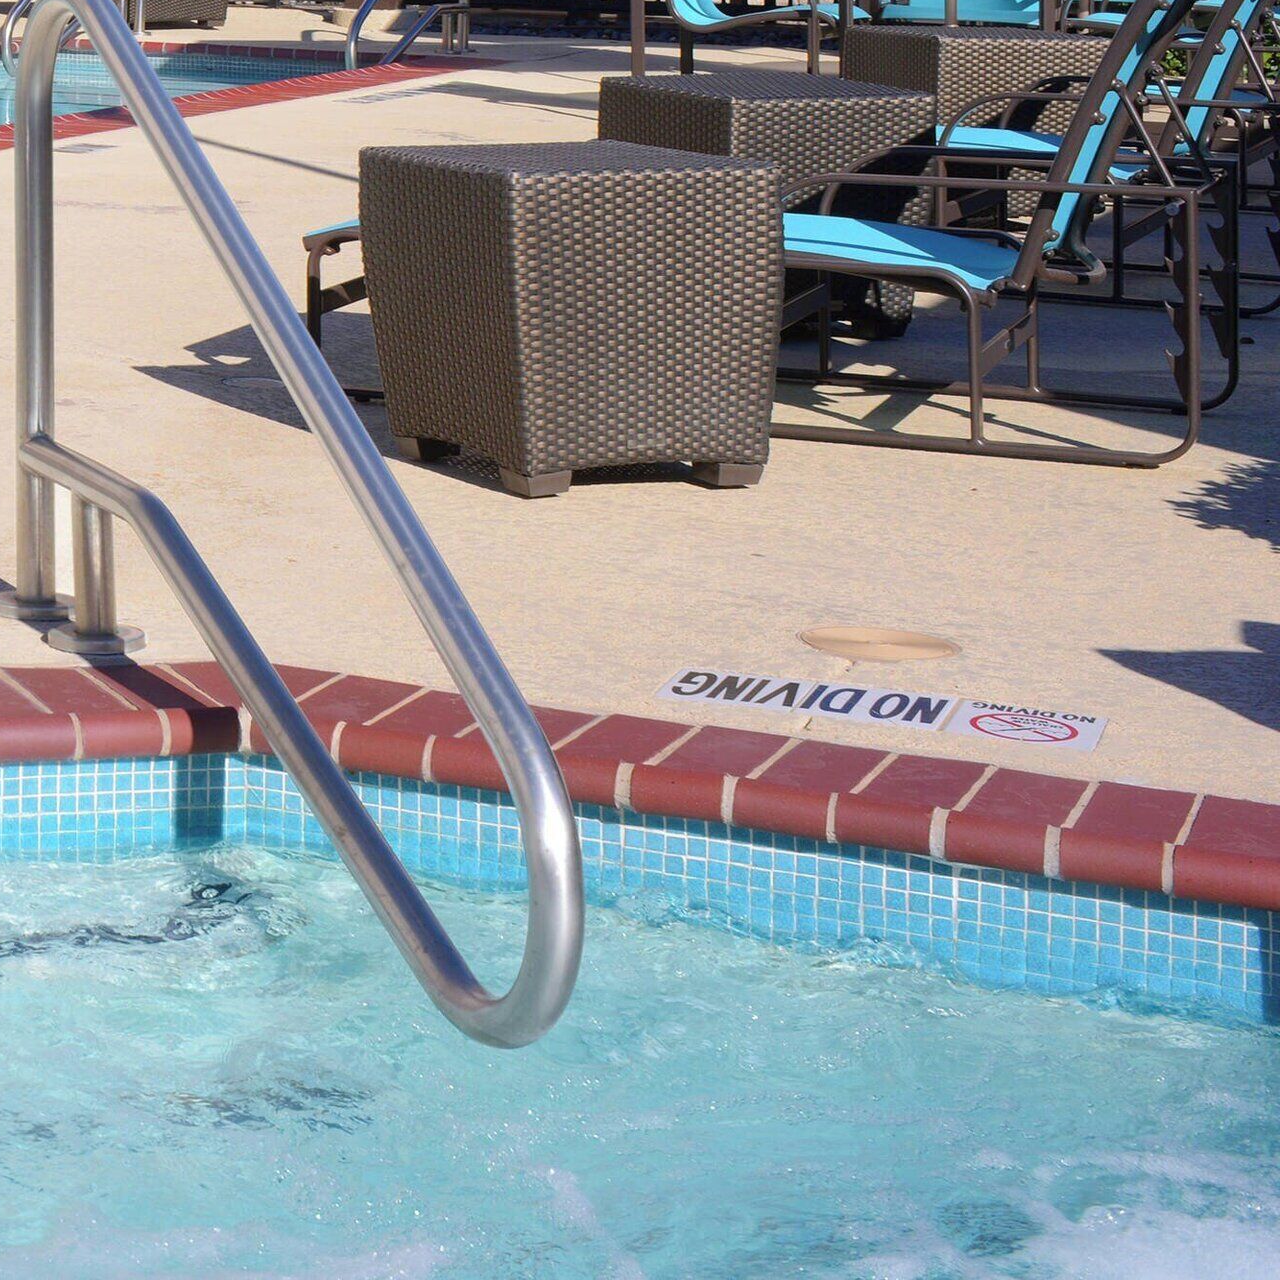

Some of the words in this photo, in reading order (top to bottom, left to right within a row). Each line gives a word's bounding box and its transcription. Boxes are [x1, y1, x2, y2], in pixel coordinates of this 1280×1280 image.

[671, 670, 869, 715] DIVING
[868, 692, 949, 725] NO
[971, 701, 1057, 718] DIVING
[1062, 713, 1097, 724] NO
